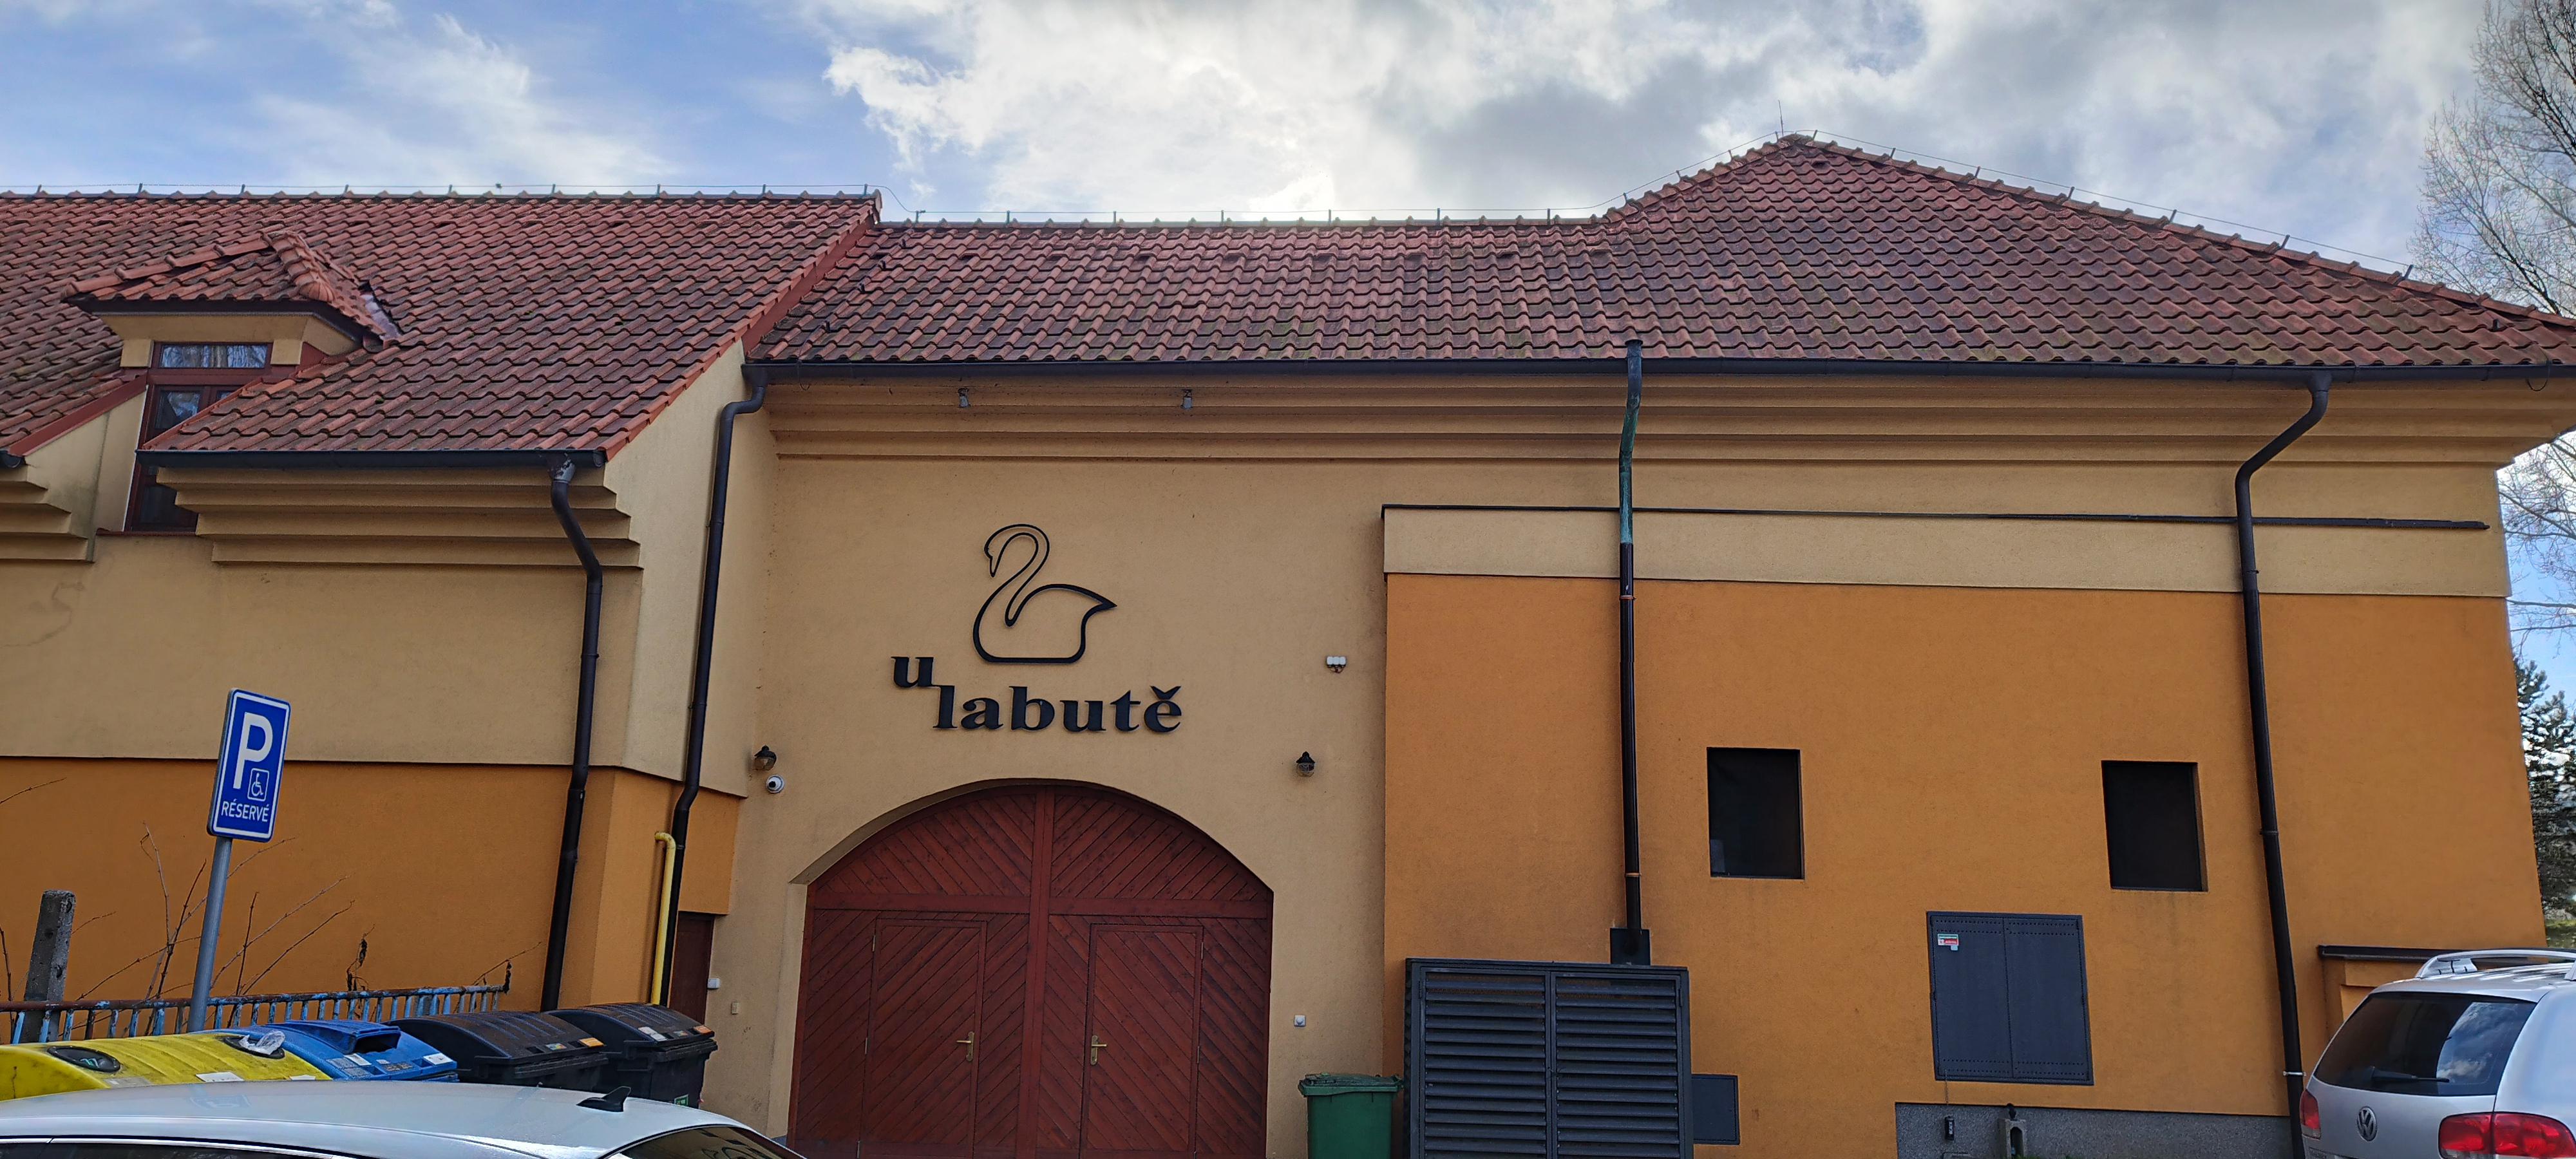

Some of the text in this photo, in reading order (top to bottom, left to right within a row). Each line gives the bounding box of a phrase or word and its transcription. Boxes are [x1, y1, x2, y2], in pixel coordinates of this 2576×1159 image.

[891, 656, 939, 688] u
[933, 685, 1182, 733] labutě
[232, 711, 273, 789] P
[221, 798, 270, 822] RÉSERVÉ
